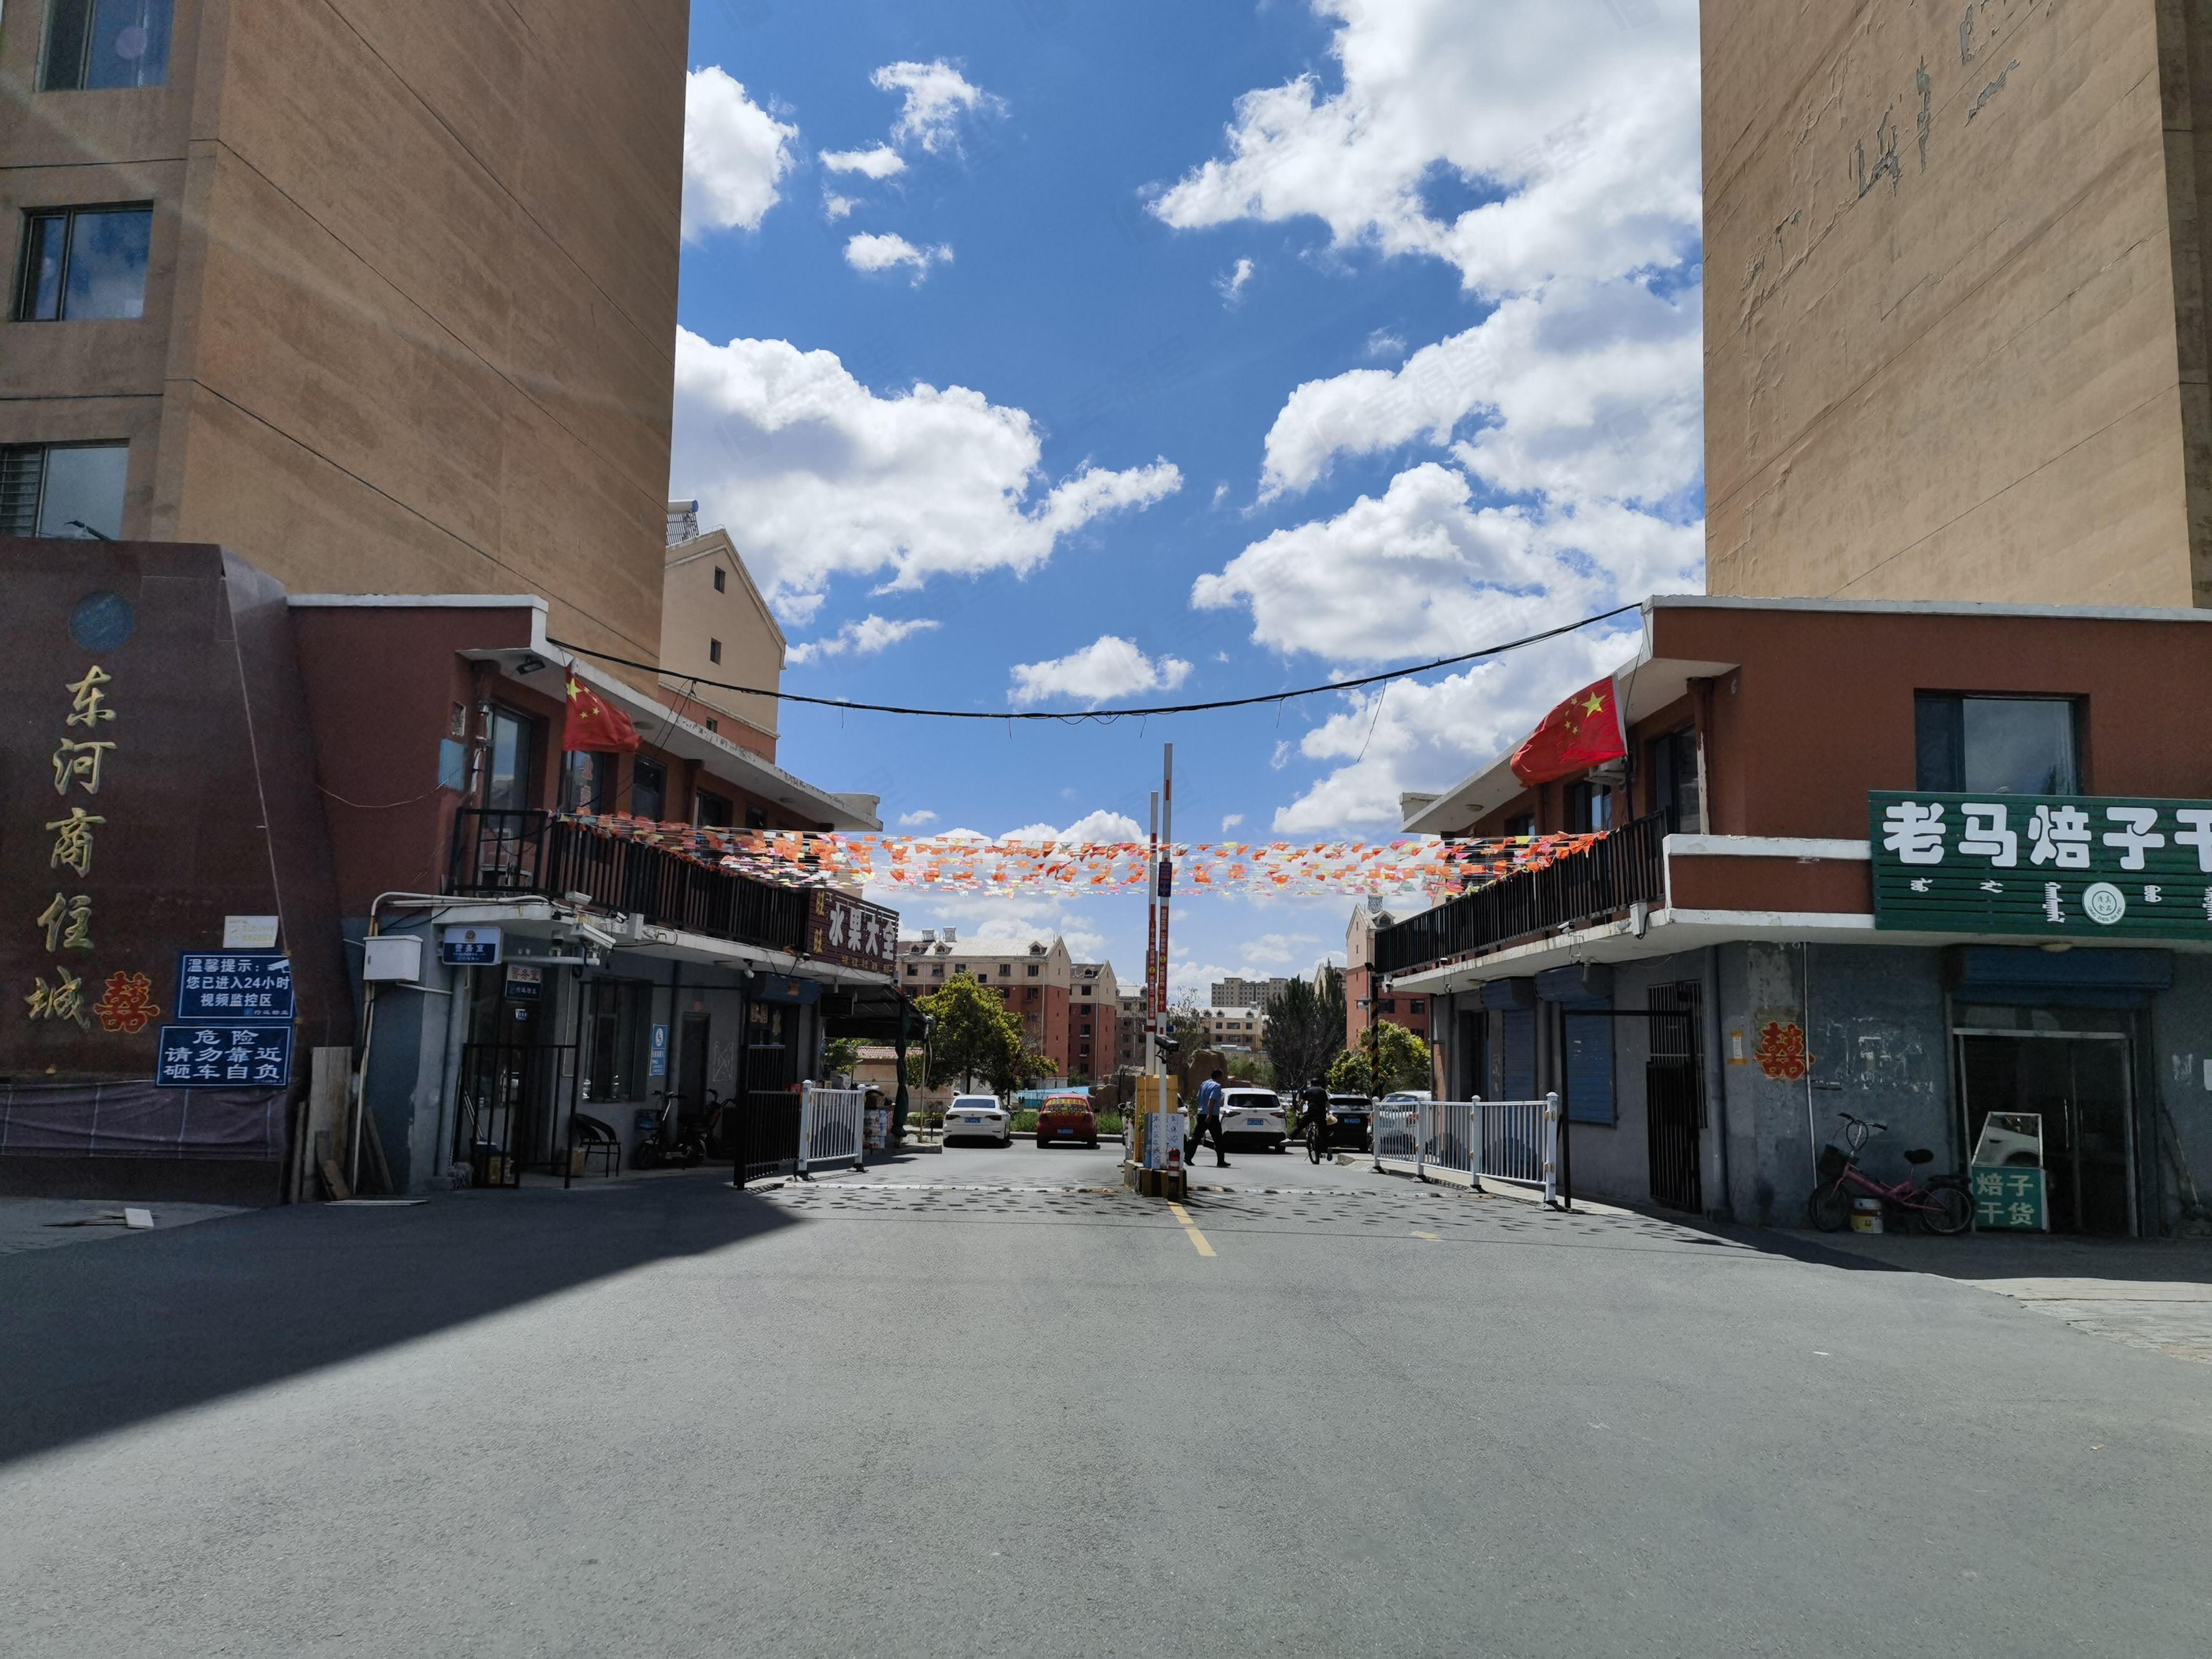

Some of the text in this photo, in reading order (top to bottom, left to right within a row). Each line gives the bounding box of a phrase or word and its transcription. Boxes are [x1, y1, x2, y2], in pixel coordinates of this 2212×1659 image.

[24, 665, 117, 1032] 东河商住城
[829, 902, 895, 961] 水果大全
[186, 976, 290, 990] 您已进入24小时
[200, 993, 273, 1007] 视频监控区
[192, 1029, 260, 1046] 危险
[164, 1047, 283, 1063] 请勿靠近
[163, 1063, 280, 1080] 砸车自负
[1976, 1172, 2034, 1197] 焙子
[1977, 1201, 2035, 1225] 干货
